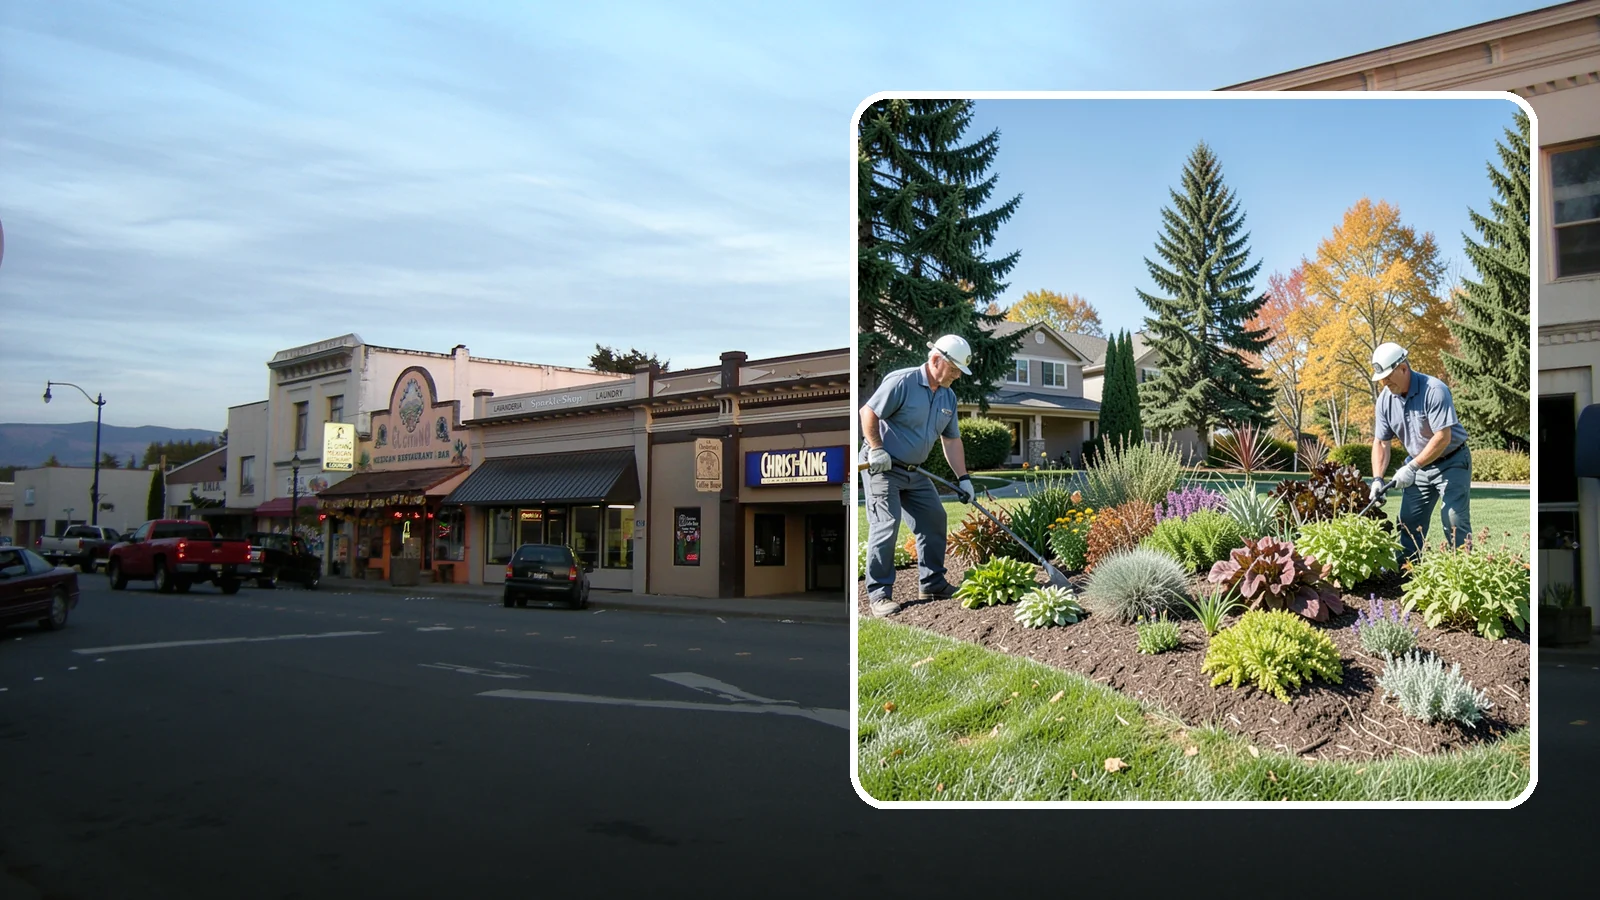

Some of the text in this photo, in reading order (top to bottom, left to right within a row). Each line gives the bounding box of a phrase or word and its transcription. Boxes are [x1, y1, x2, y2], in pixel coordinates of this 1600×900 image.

[530, 394, 583, 410] Sparkle Shop
[595, 389, 624, 400] LAUNDRY
[493, 402, 523, 413] LAVANDERIA
[391, 426, 402, 449] EL
[373, 455, 396, 465] MEXICAN
[397, 451, 434, 463] RESTAURANT
[437, 450, 450, 460] BAR
[761, 450, 828, 478] CHRIST KING
[696, 481, 709, 489] Coffee
